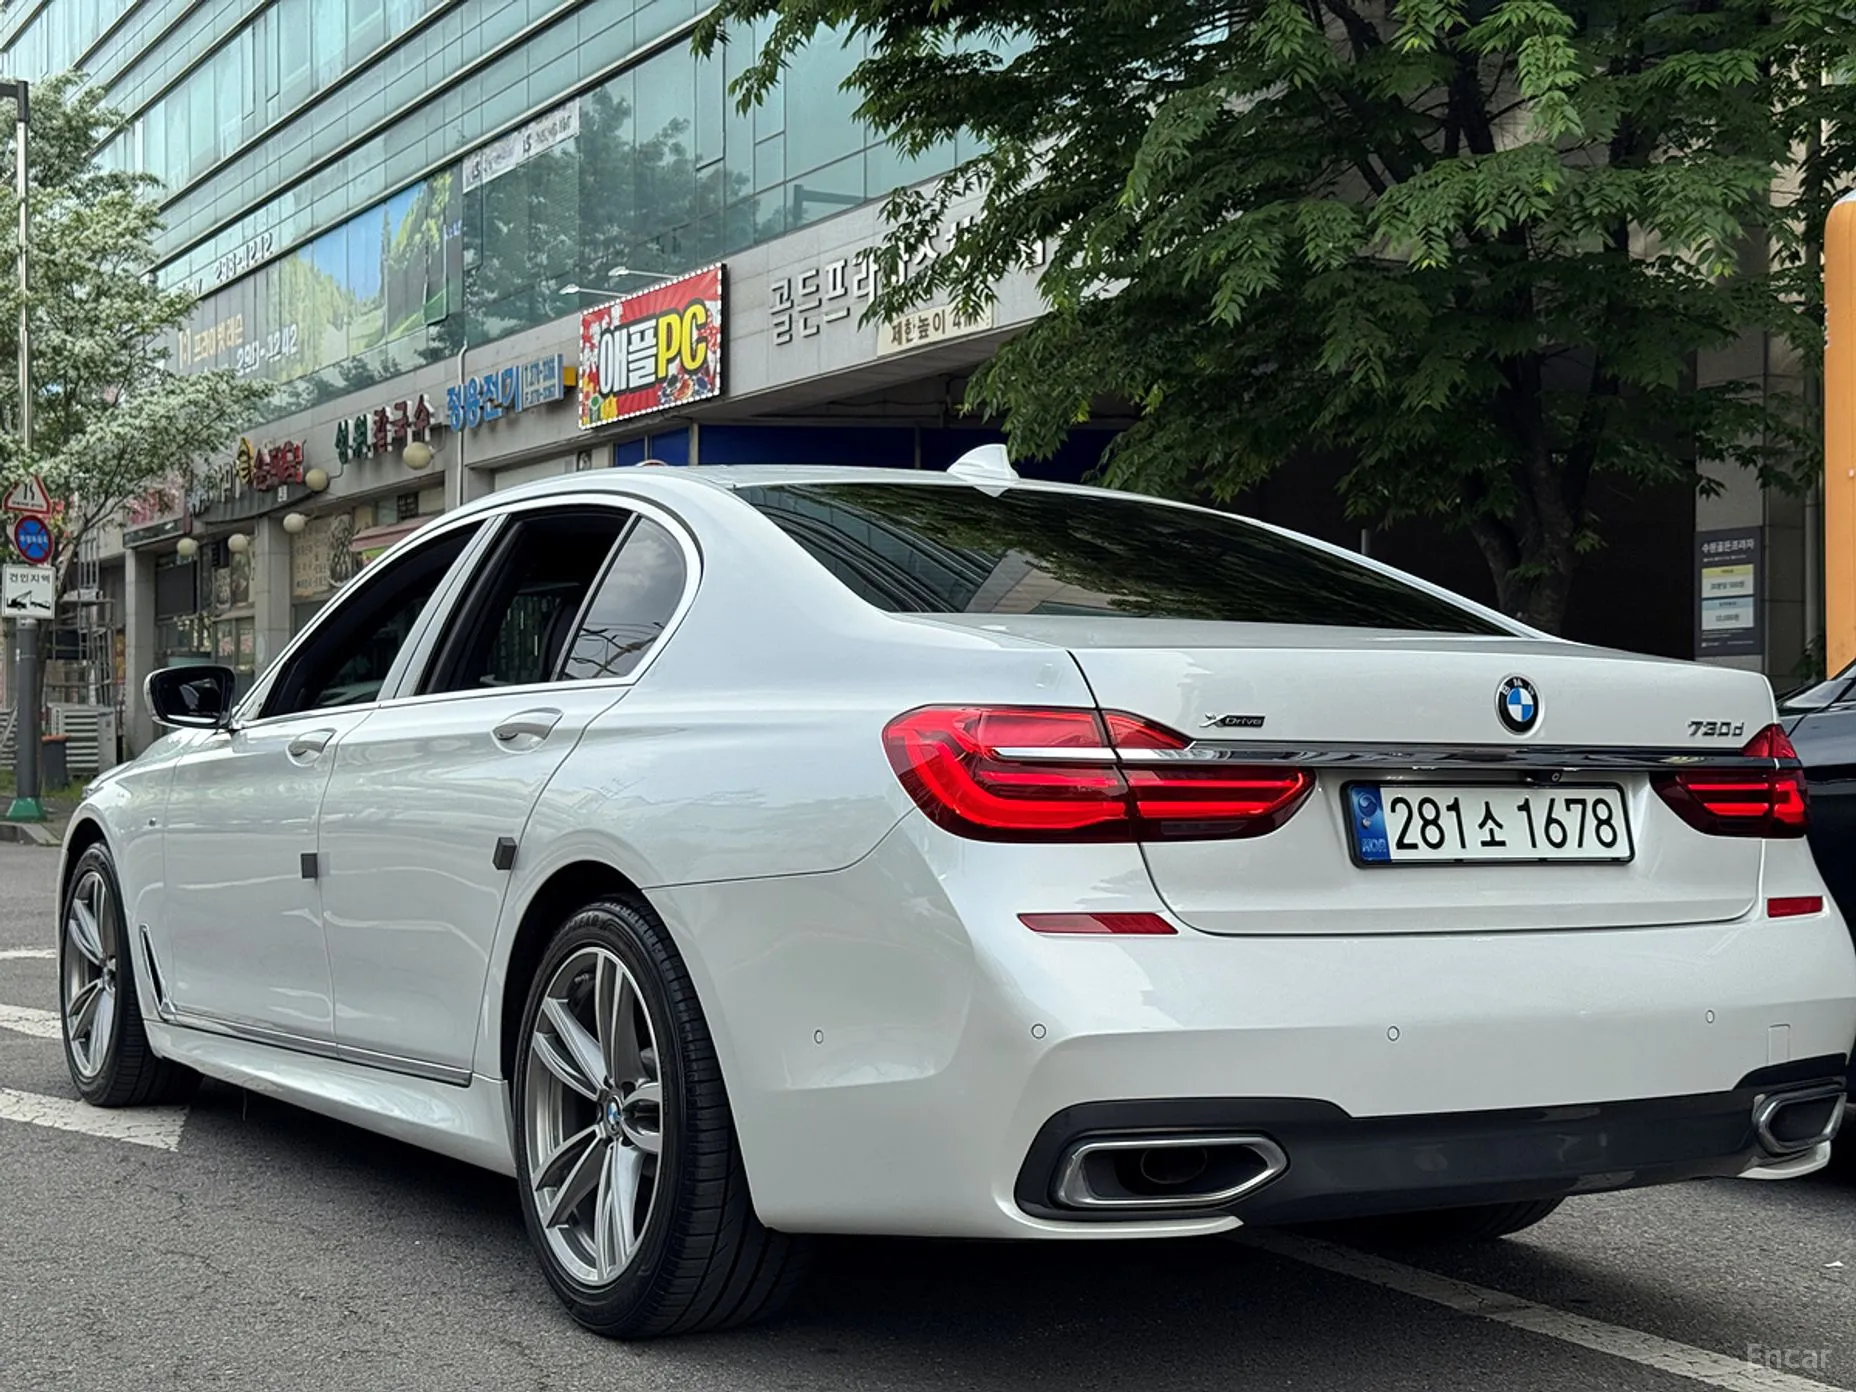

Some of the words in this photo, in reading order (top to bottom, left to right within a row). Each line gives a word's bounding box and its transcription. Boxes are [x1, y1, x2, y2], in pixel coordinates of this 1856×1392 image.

[891, 309, 946, 346] 제한높이
[600, 303, 707, 395] 애플PC
[9, 572, 51, 584] 견인지역
[1687, 720, 1744, 738] 730d
